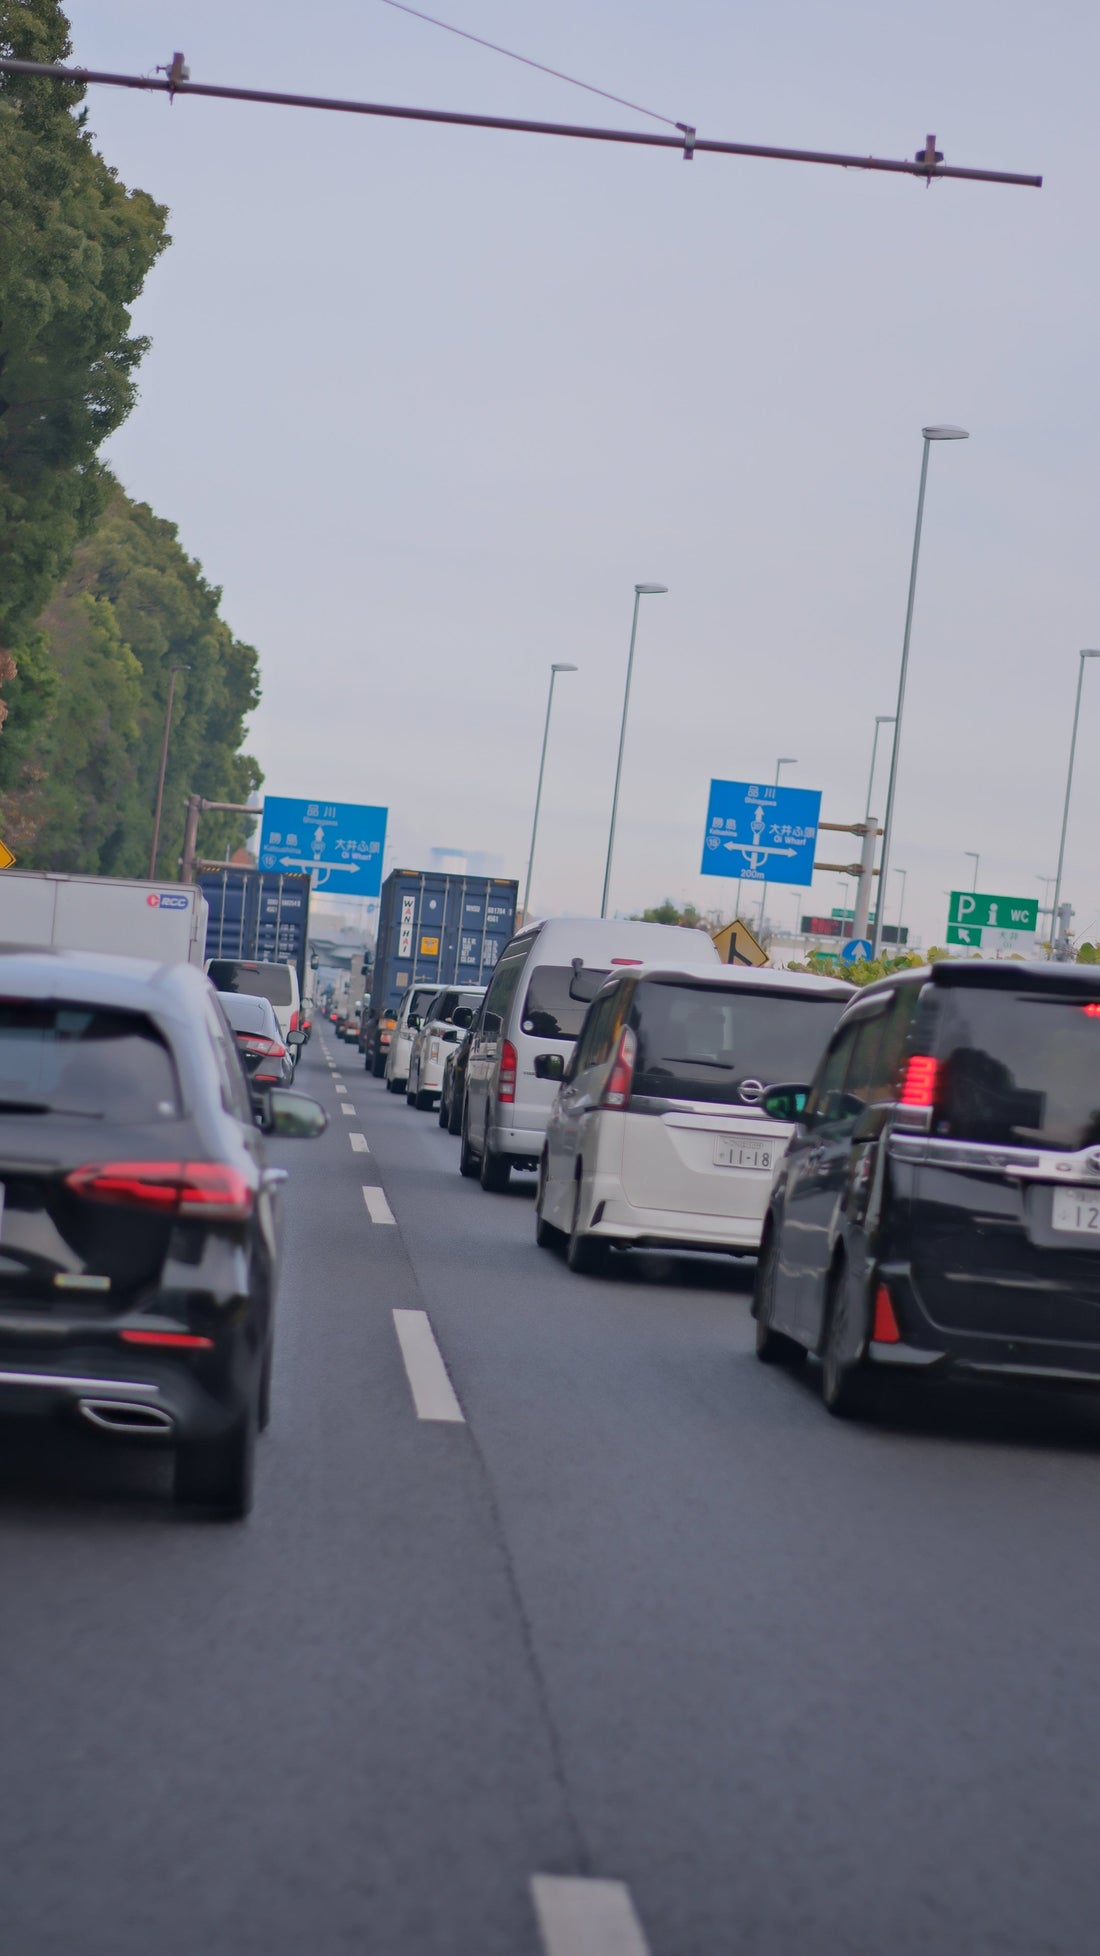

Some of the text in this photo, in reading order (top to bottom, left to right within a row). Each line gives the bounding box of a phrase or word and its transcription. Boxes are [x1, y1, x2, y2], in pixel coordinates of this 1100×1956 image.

[748, 785, 776, 799] 品川
[306, 804, 337, 818] 品川
[740, 868, 765, 880] 200m
[957, 894, 976, 922] P
[1010, 909, 1030, 923] WC
[402, 900, 413, 953] WAN HAI
[729, 1149, 770, 1167] 11-18
